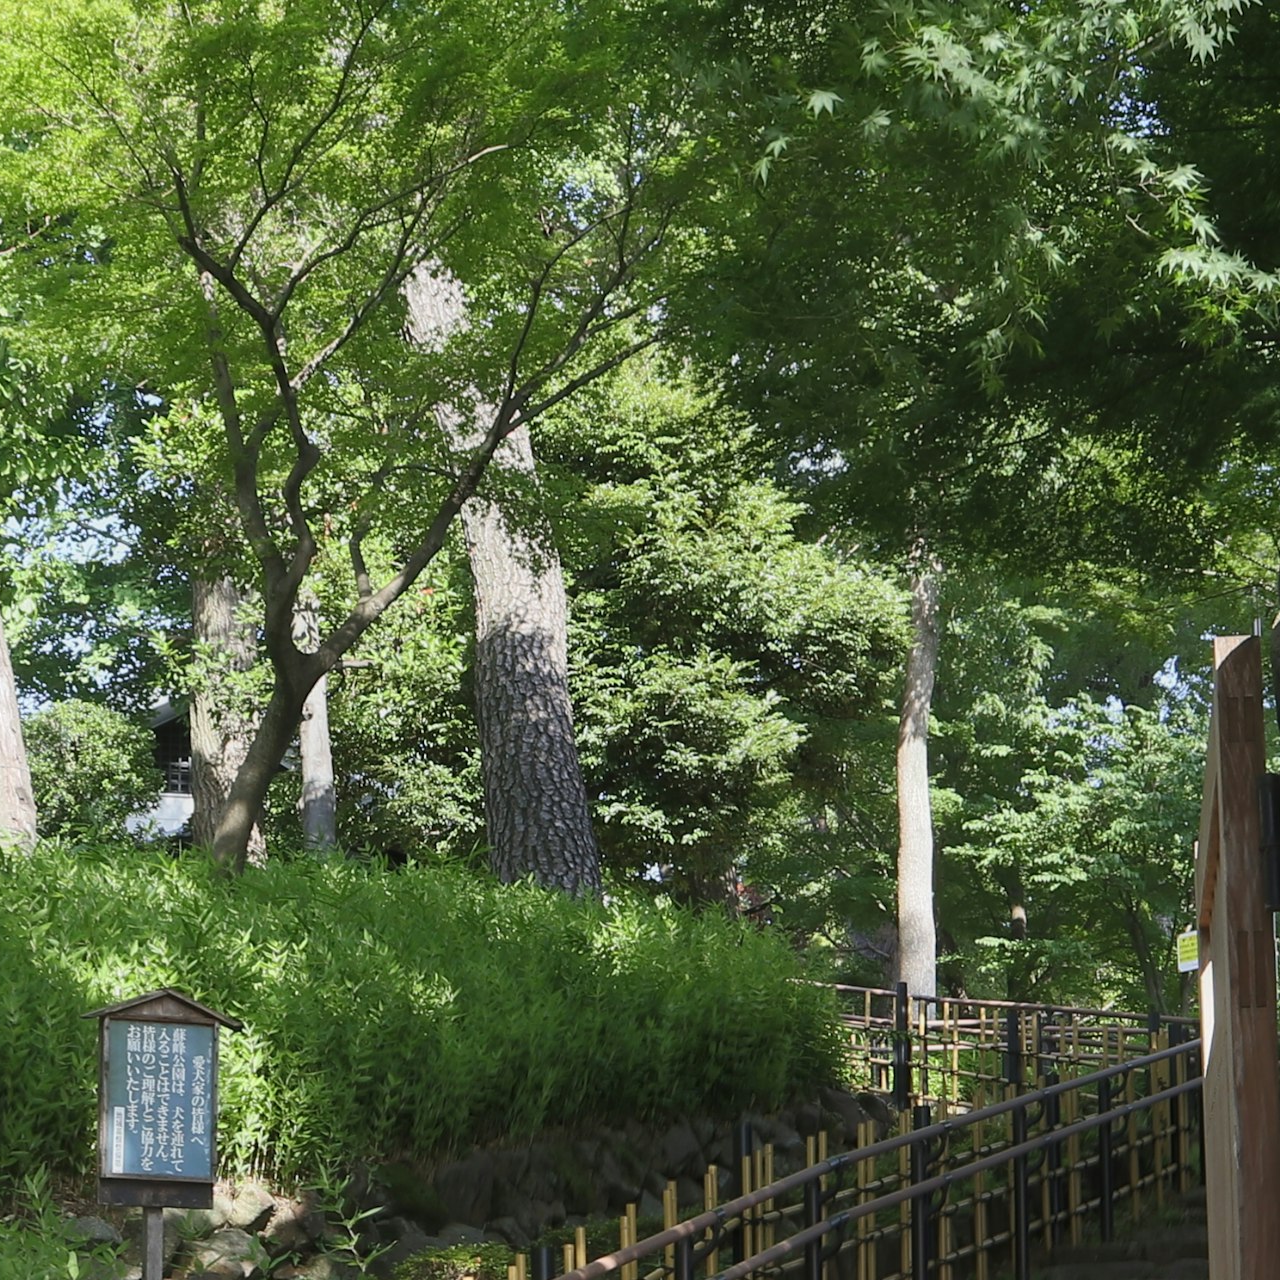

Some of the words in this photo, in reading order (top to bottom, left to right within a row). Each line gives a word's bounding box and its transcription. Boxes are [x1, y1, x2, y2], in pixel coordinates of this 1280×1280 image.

[126, 1025, 140, 1133] お願いいたします。
[141, 1025, 155, 1171] 皆様のご理解とご協力を
[155, 1028, 170, 1161] 入ることはできません。
[191, 1055, 204, 1145] 愛犬家の皆様へ
